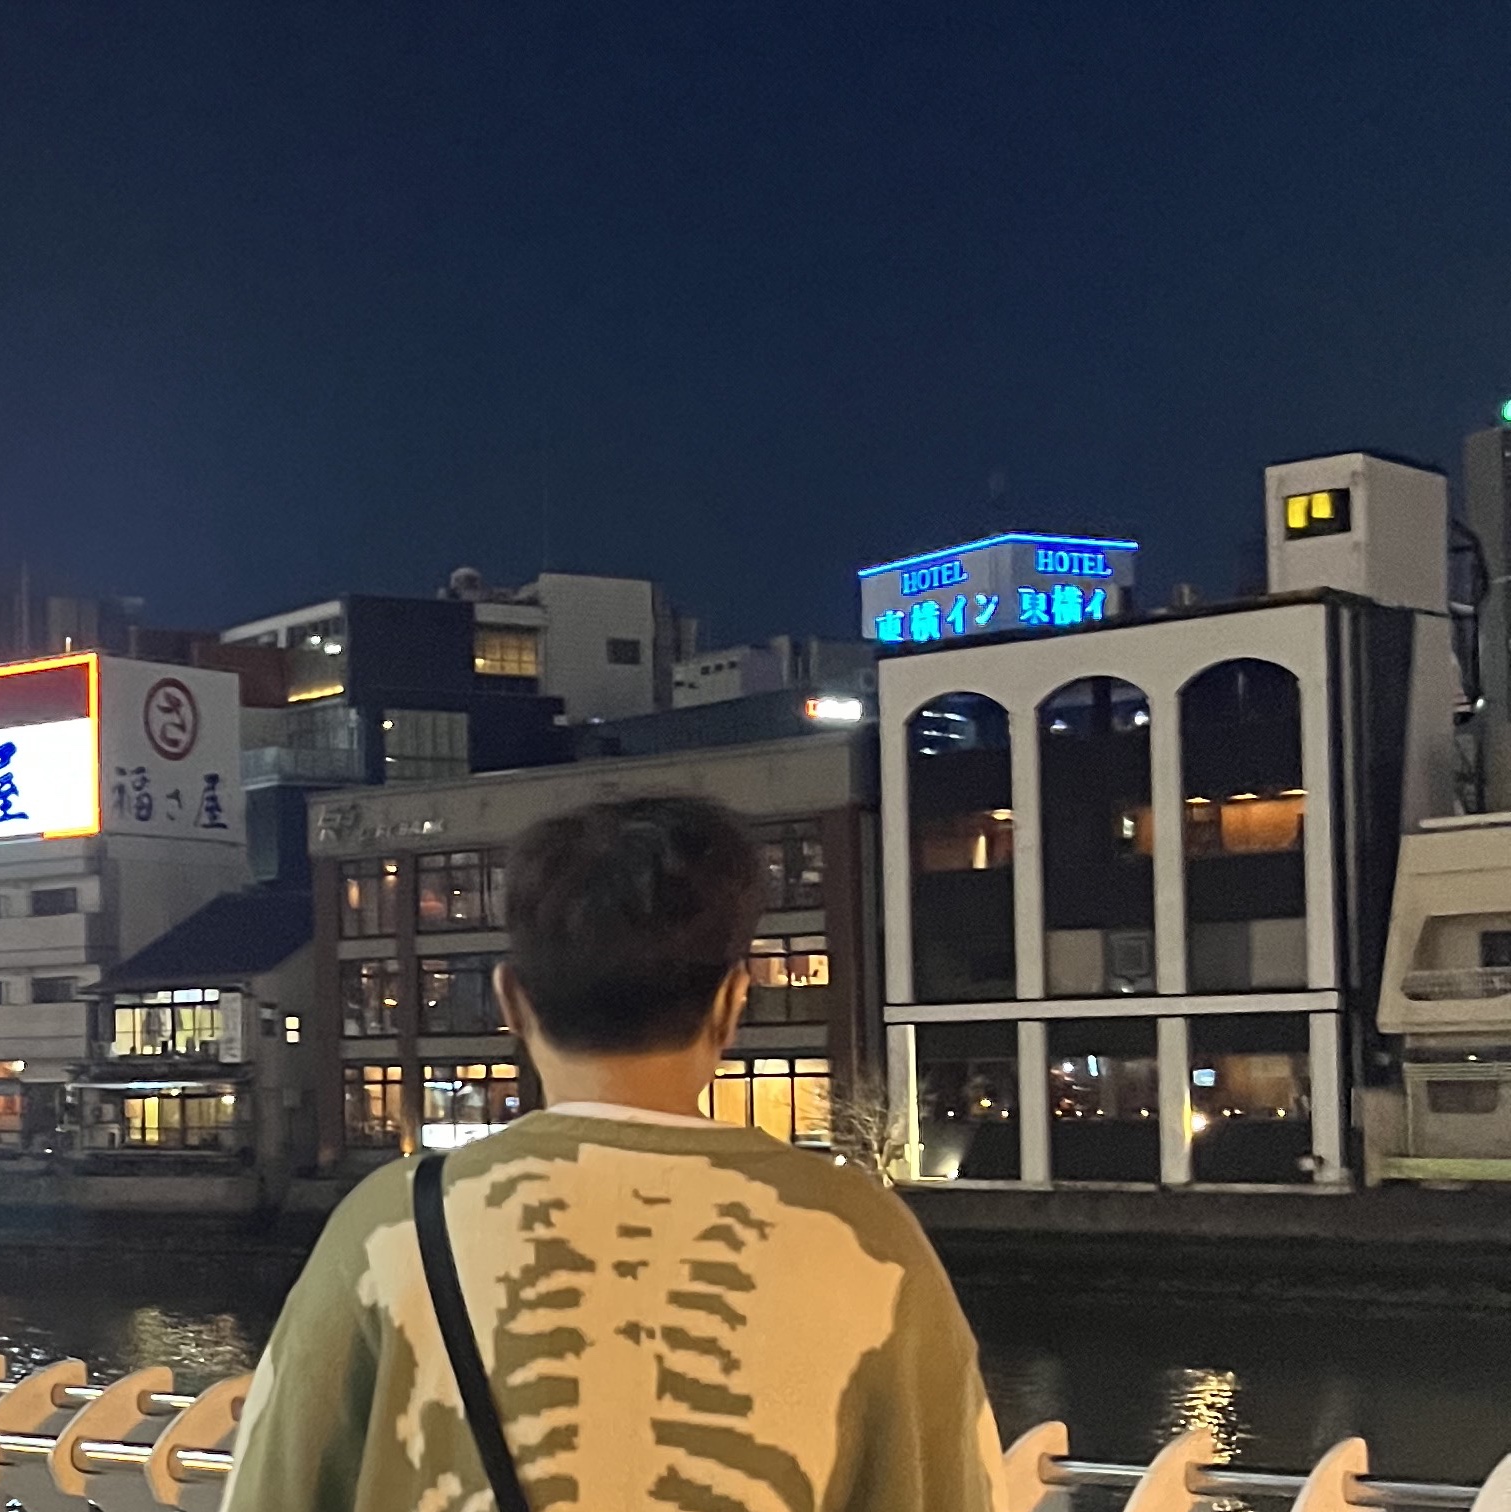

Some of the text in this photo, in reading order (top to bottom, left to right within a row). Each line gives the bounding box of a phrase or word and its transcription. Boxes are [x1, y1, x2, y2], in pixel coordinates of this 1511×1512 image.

[902, 560, 968, 596] HOTEL
[1035, 549, 1111, 577] HOTEL
[110, 765, 229, 829] 福さ屋
